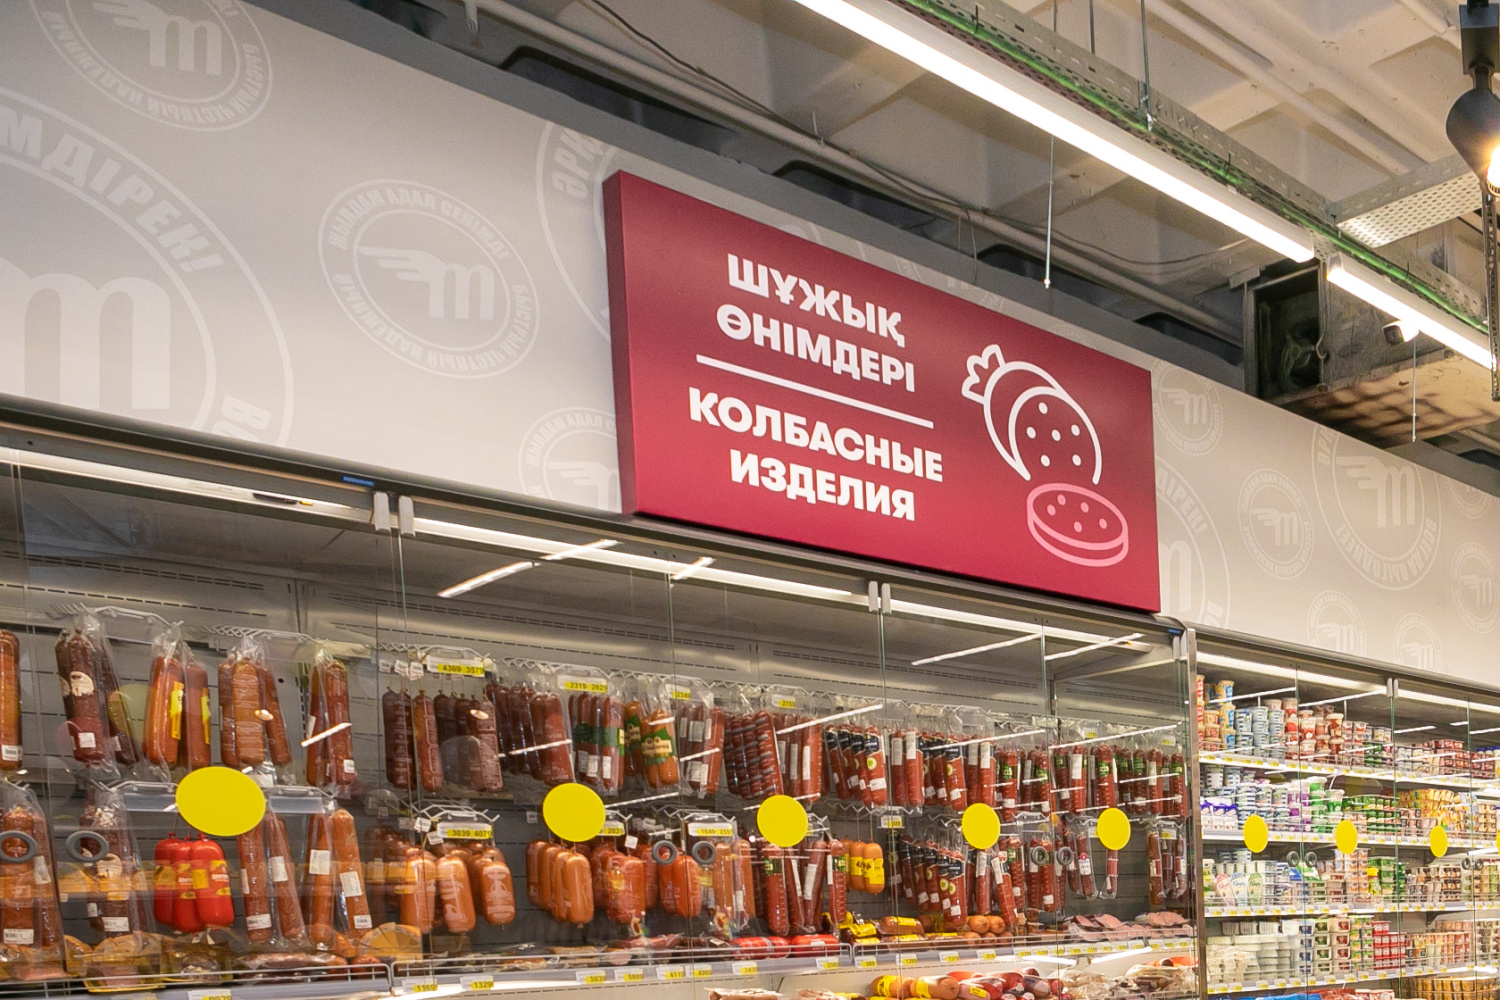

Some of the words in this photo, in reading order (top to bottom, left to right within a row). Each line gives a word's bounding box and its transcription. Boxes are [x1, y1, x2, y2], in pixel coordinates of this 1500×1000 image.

[726, 253, 906, 348] ШҰЖЫҚ
[716, 305, 916, 393] ӨНІМДЕРІ
[688, 386, 944, 484] КОЛБАСНЫЕ
[729, 449, 916, 522] ИЗДЕЛИЯ
